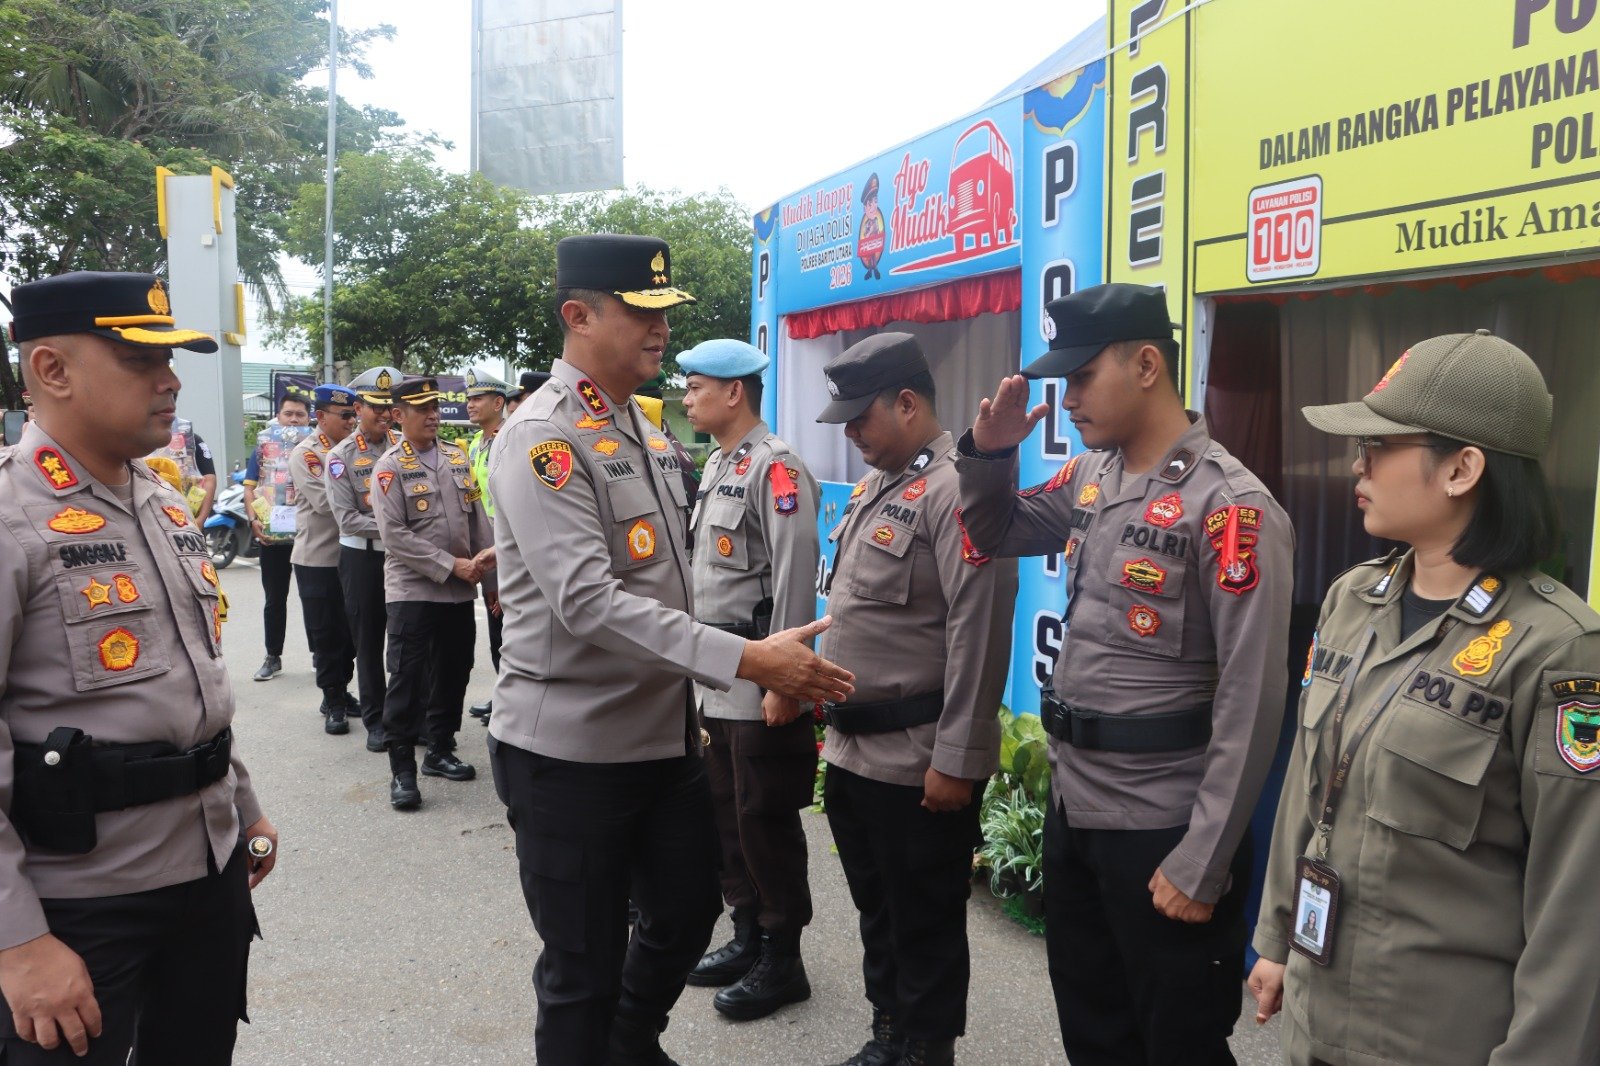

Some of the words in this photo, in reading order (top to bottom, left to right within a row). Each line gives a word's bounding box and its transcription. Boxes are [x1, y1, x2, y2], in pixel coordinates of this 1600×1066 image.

[1259, 121, 1331, 170] DALAM
[1336, 93, 1439, 152] RANGKA
[1446, 49, 1599, 127] PELAYANA
[1531, 112, 1600, 169] POL
[894, 153, 929, 212] Ayo
[782, 193, 813, 229] Mudik
[815, 183, 853, 216] Happy
[1256, 196, 1289, 211] LAYANAN
[1289, 191, 1312, 205] POLISI
[827, 213, 853, 241] POLISI
[890, 192, 951, 252] Mudik
[1395, 206, 1508, 253] Mudik
[1257, 216, 1313, 259] 110
[830, 264, 852, 289] 2026
[531, 442, 569, 457] RESERSE
[401, 471, 427, 481] SUGENG
[602, 460, 635, 478] IWAN
[717, 484, 745, 499] POLRI
[880, 503, 917, 525] POLRI
[1207, 508, 1256, 527] POLES
[1208, 519, 1230, 533] BARIT
[1236, 516, 1256, 526] TARA
[1121, 523, 1188, 558] POLRI
[1408, 670, 1455, 709] POL
[1461, 690, 1504, 724] PP
